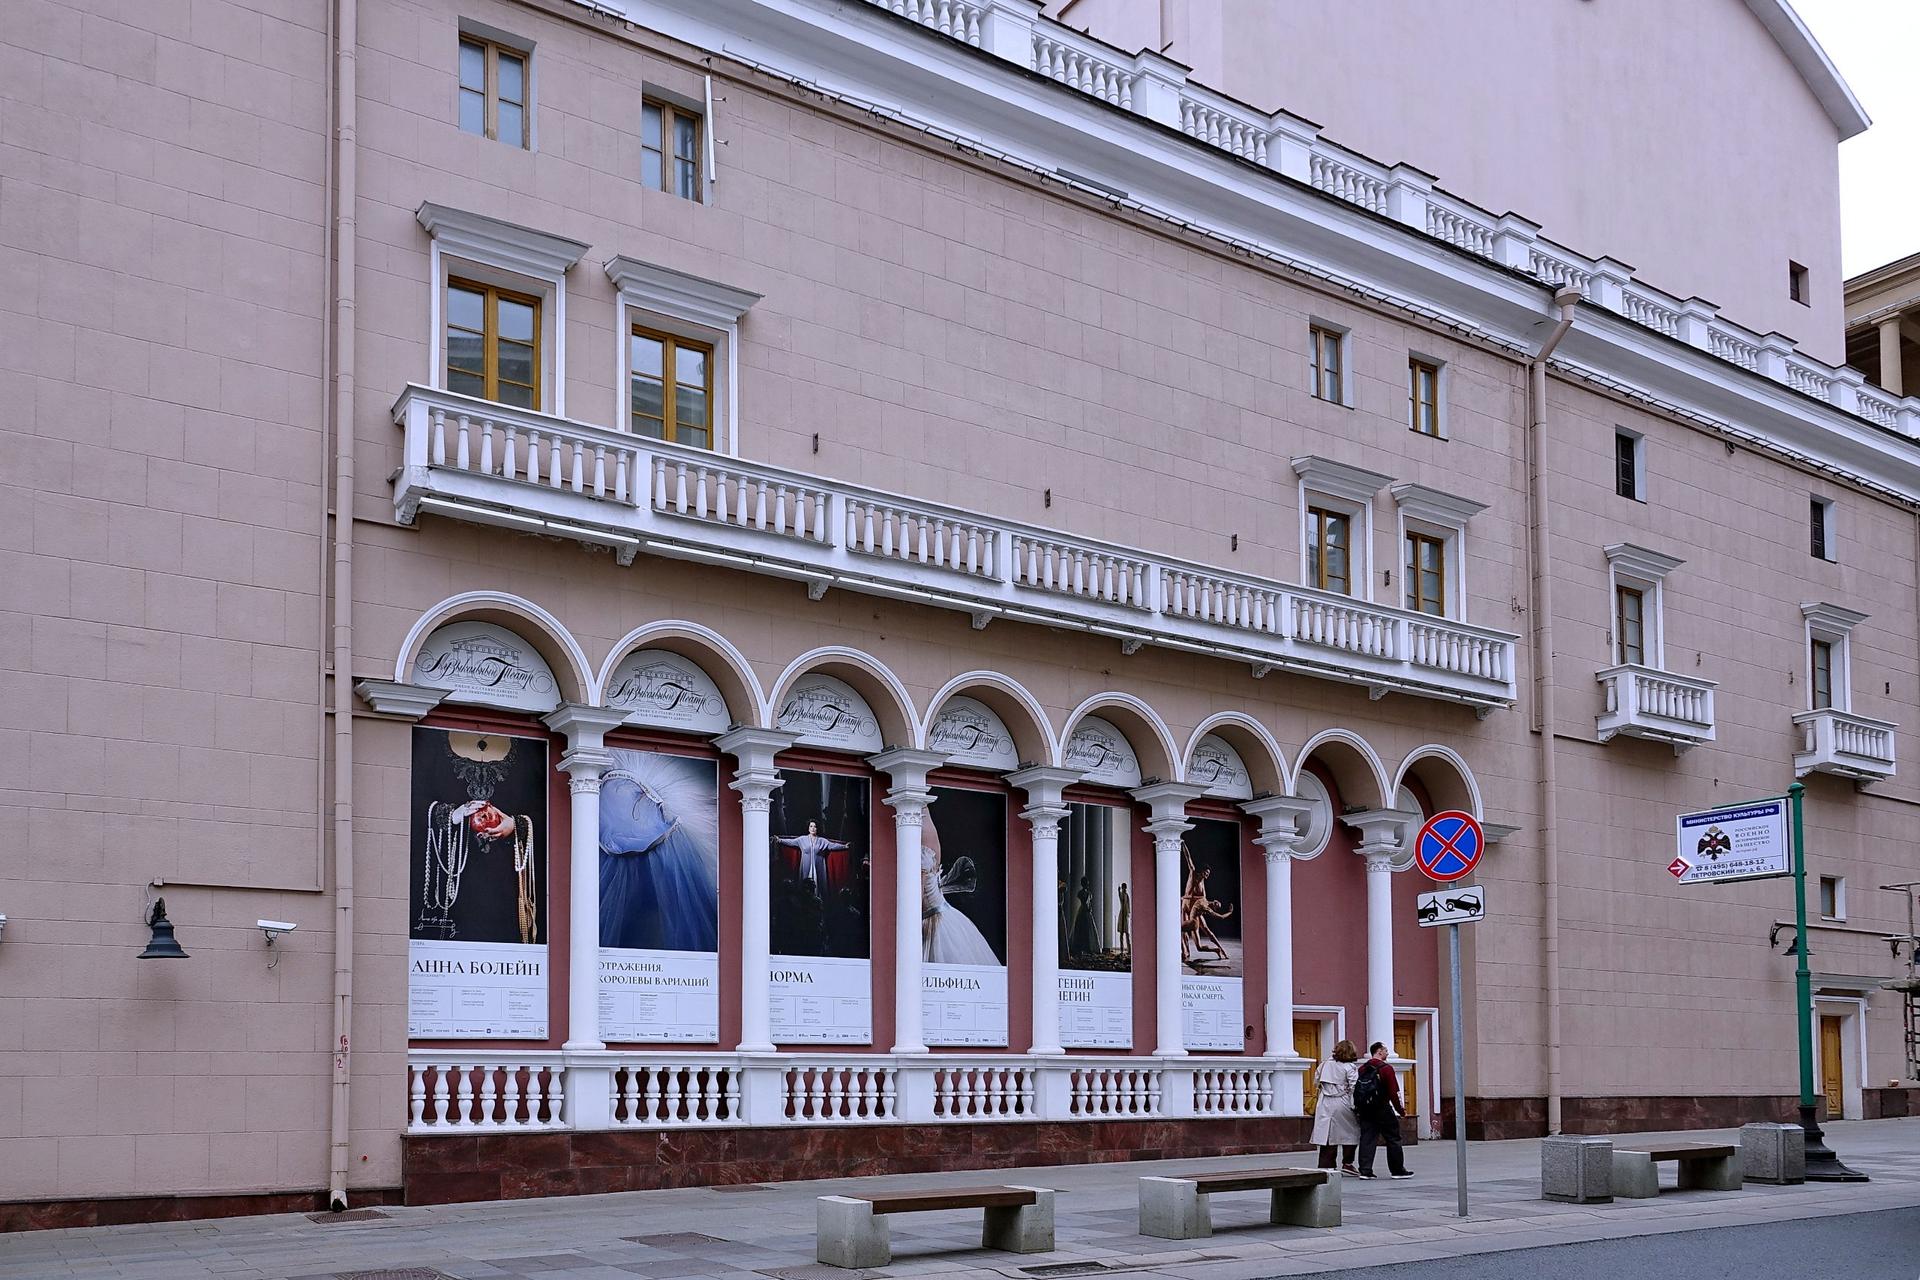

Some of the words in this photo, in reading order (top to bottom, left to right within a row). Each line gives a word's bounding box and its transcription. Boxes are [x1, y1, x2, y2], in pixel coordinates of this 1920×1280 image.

[1686, 813, 1733, 825] МИНИСТЕРСТВО
[1733, 809, 1764, 819] КУЛЬТУРЫ
[1710, 863, 1728, 871] (495)
[1691, 868, 1735, 879] ПЕТРОВСКИЙ
[411, 959, 465, 974] АННА
[470, 960, 541, 976] БОЛЕЙН
[655, 977, 710, 987] ВАРИАЦИЙ
[922, 976, 981, 991] ИЛЬФИДА
[1058, 977, 1094, 990] ГЕНИЙ
[1059, 990, 1090, 1002] ЕГИН
[1181, 992, 1201, 1000] НЬКАЯ
